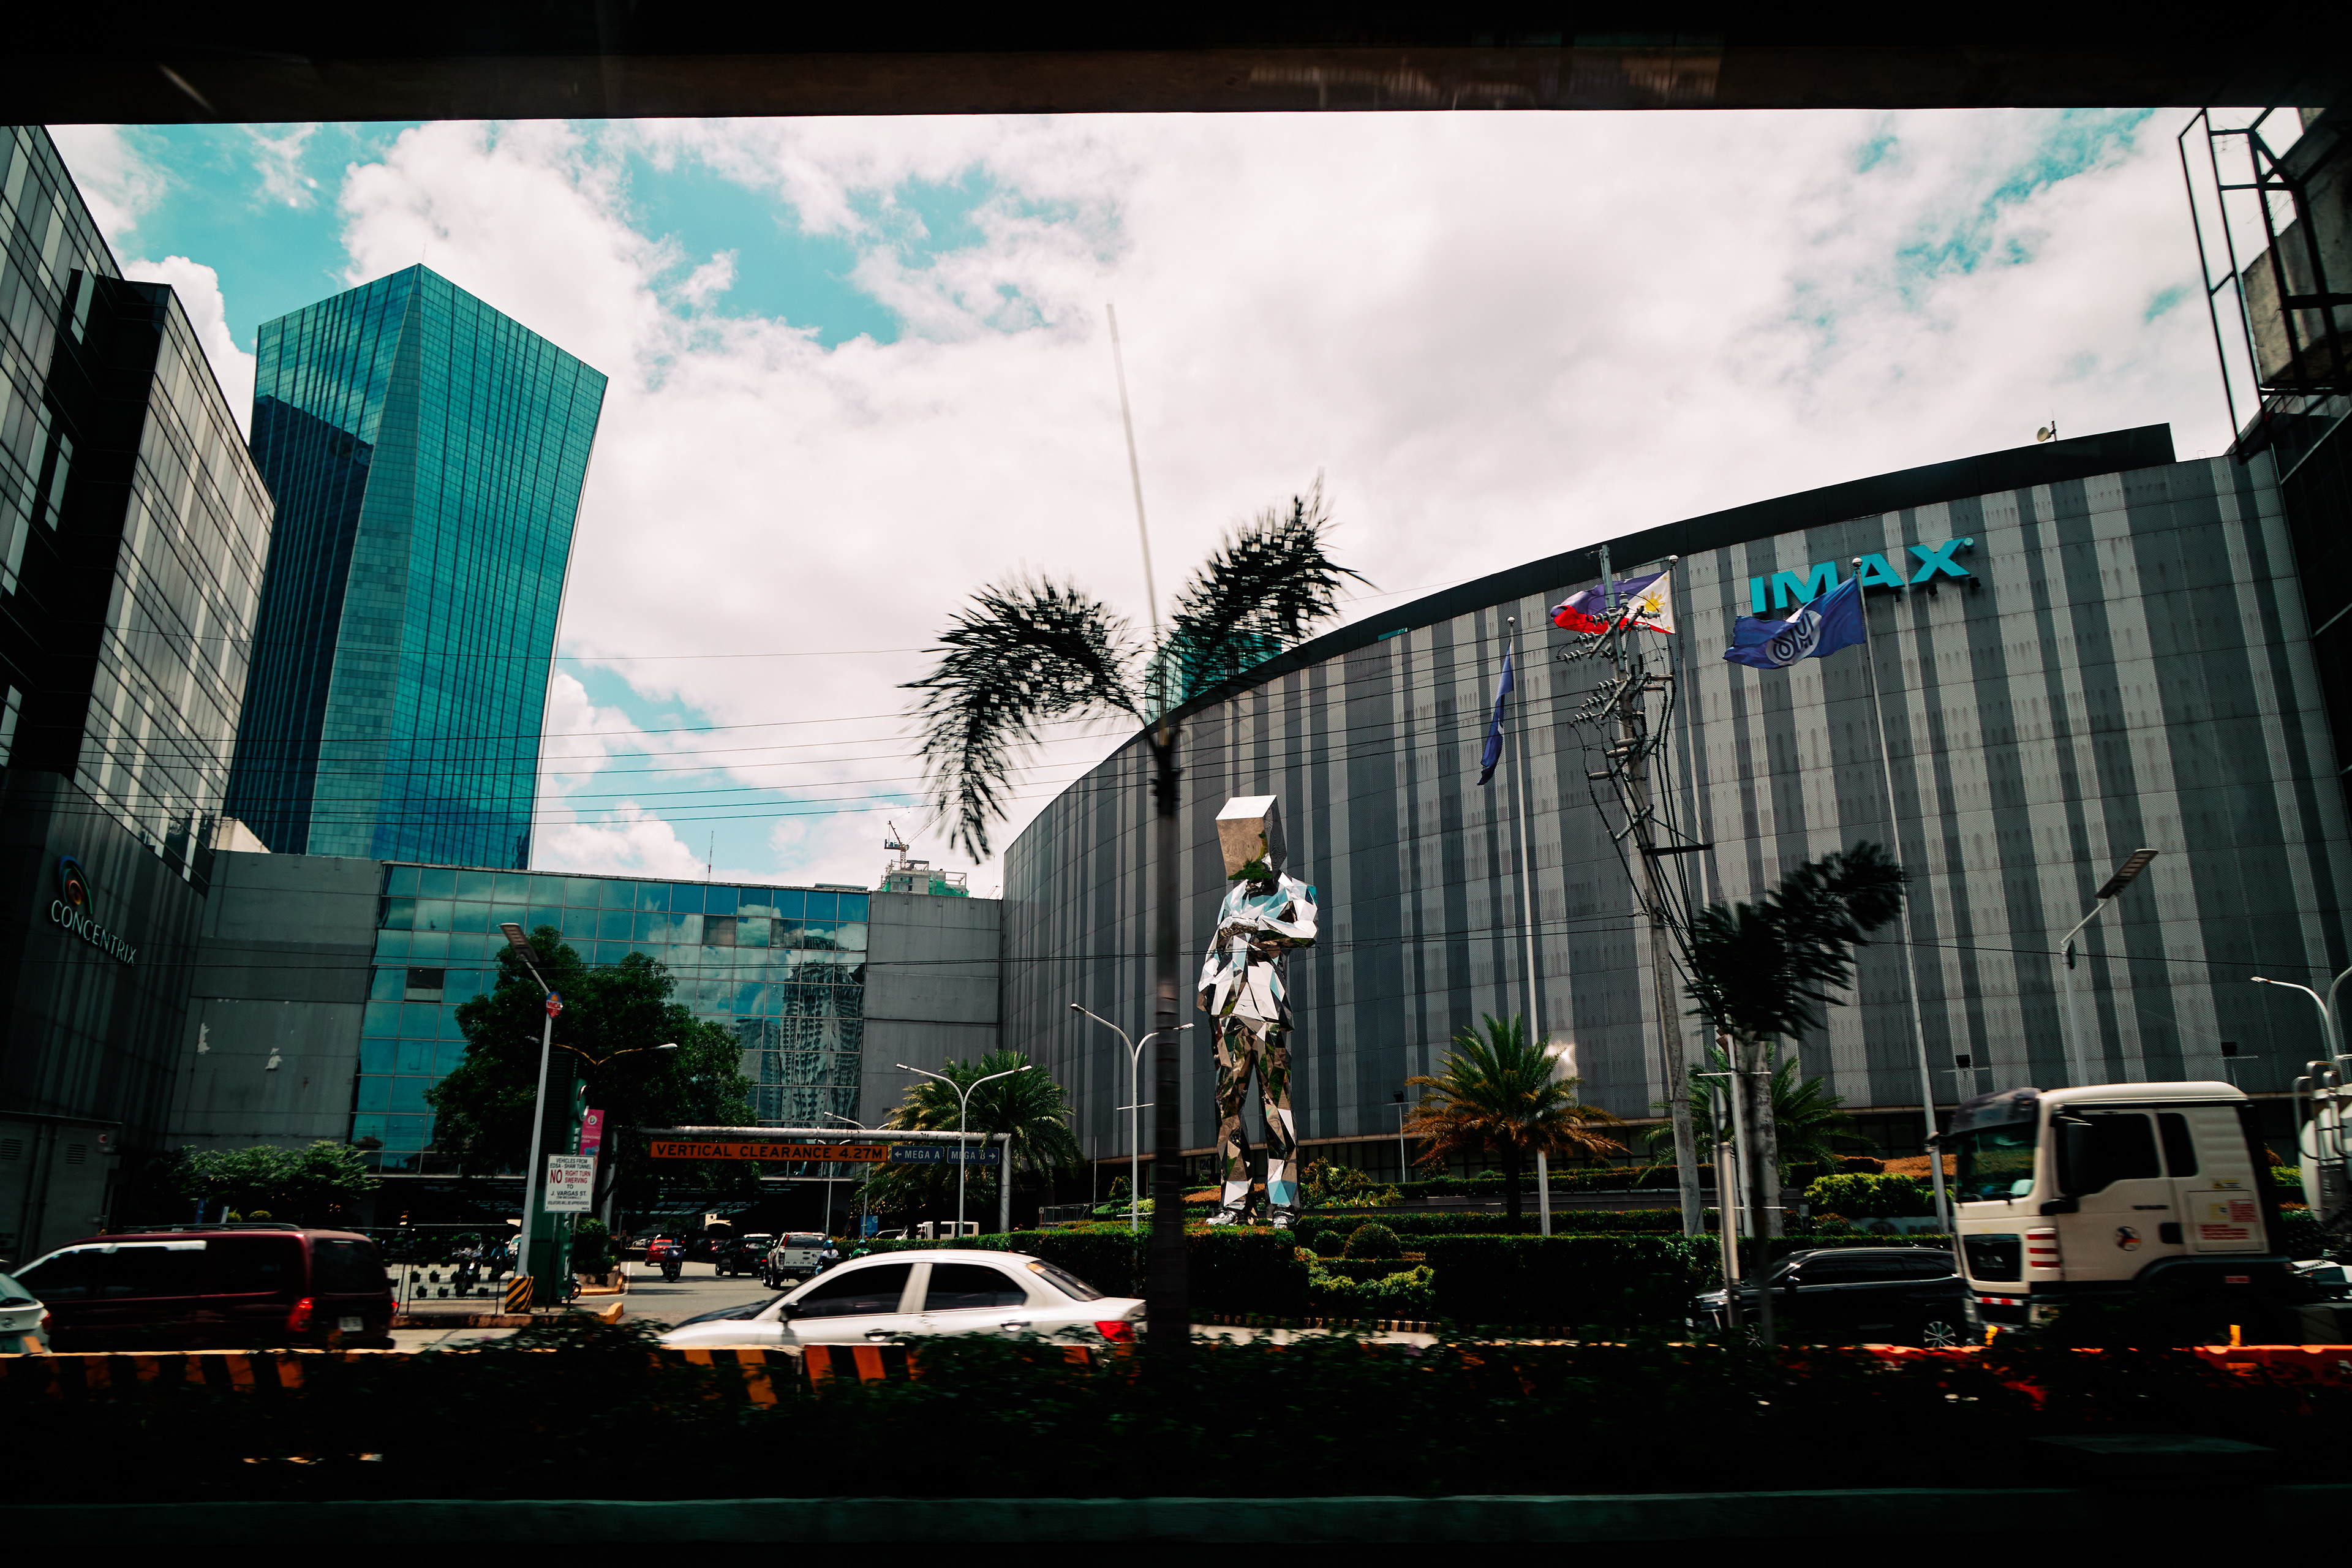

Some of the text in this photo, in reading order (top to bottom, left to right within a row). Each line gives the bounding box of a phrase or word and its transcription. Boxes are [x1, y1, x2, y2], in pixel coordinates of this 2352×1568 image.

[1750, 538, 1970, 613] IMAX
[51, 900, 137, 966] CONCENTRIX
[657, 1144, 882, 1159] VERTICAL CLEARANCE 4.27M
[905, 1150, 930, 1159] MEGA
[550, 1169, 562, 1183] NO
